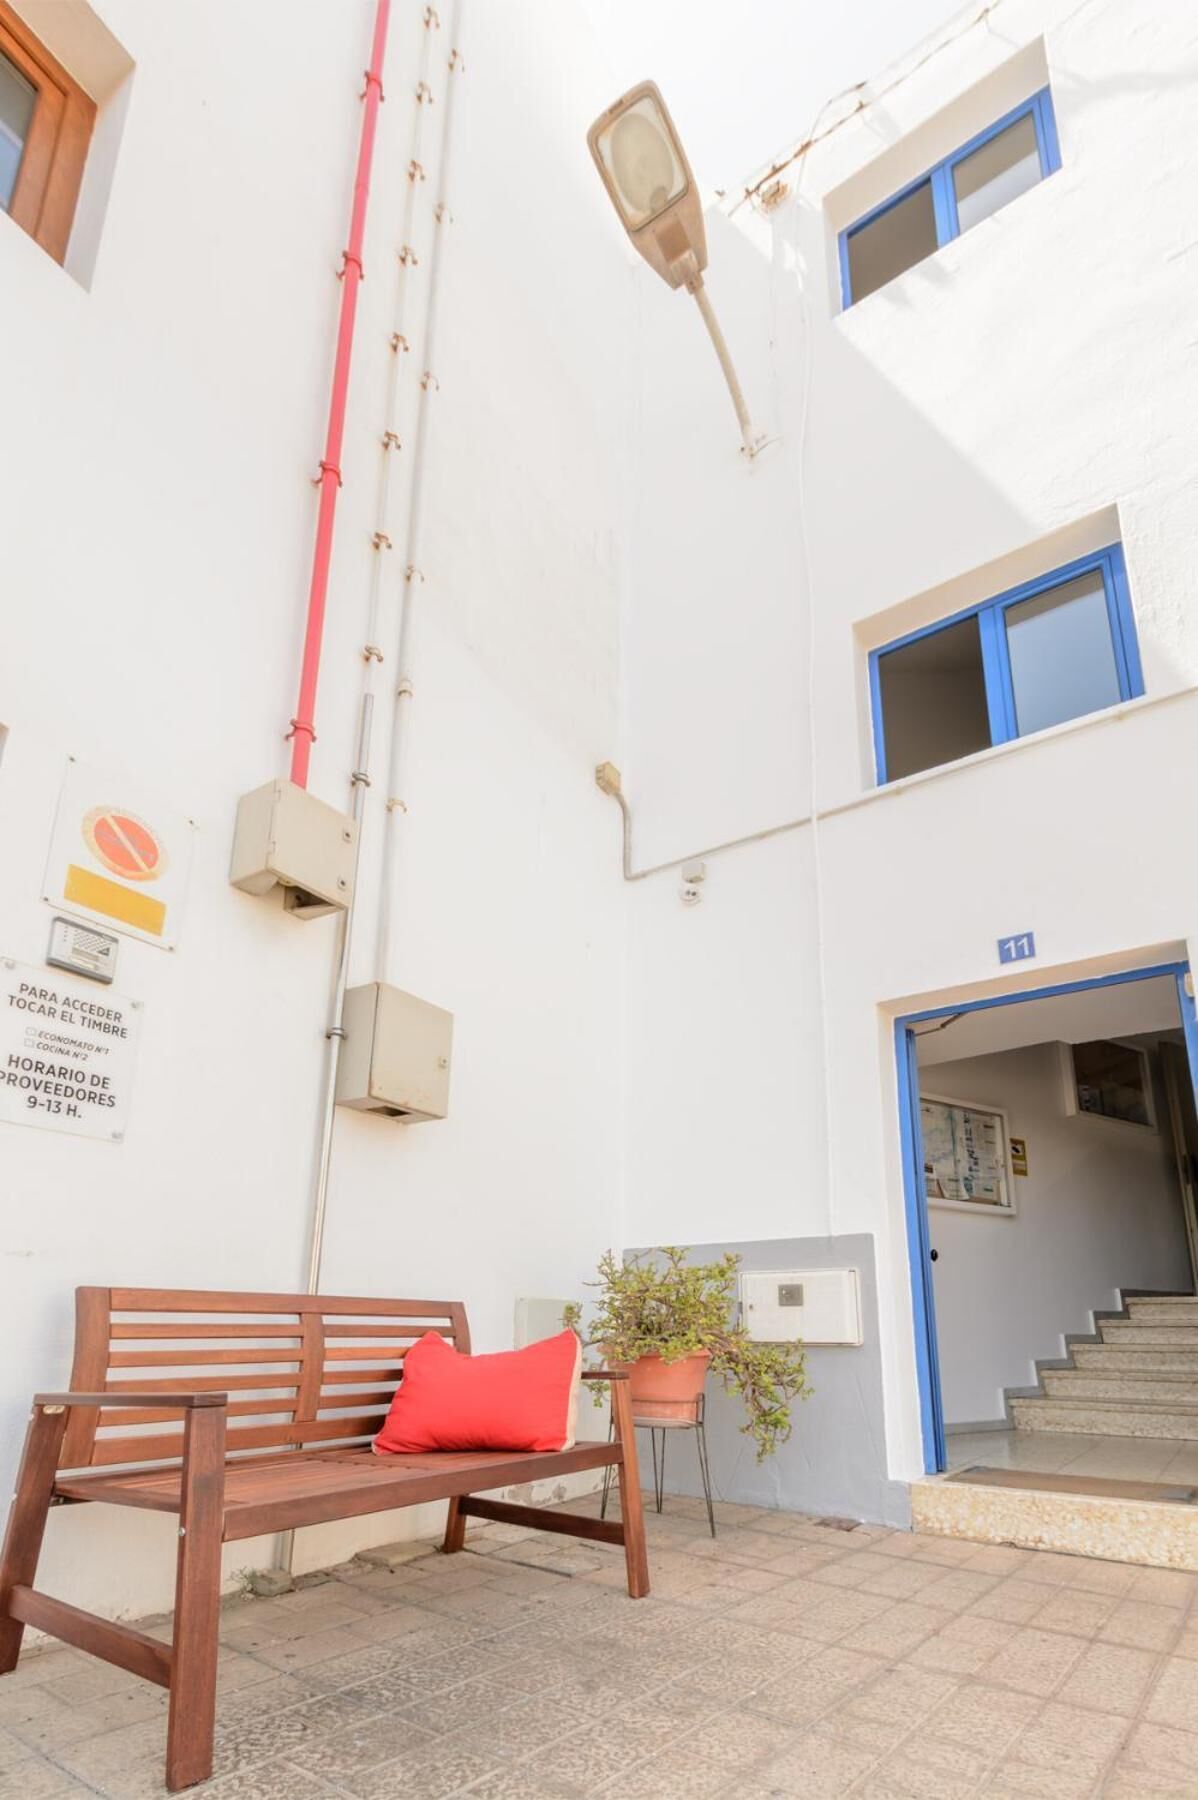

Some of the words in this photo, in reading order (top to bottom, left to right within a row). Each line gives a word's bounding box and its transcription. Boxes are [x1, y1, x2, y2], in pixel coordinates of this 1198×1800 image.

[1004, 936, 1030, 959] 11
[20, 983, 58, 1004] PARA
[62, 997, 122, 1023] ACCEDER
[8, 995, 57, 1019] TOCAR
[60, 1010, 76, 1025] EL
[80, 1015, 128, 1039] TIMBRE
[36, 1042, 71, 1057] COCINA
[38, 1031, 94, 1051] ECONOMATO
[8, 1054, 86, 1084] HORARIO
[90, 1074, 111, 1090] DE
[27, 1095, 62, 1114] 9-13
[66, 1104, 82, 1118] H.
